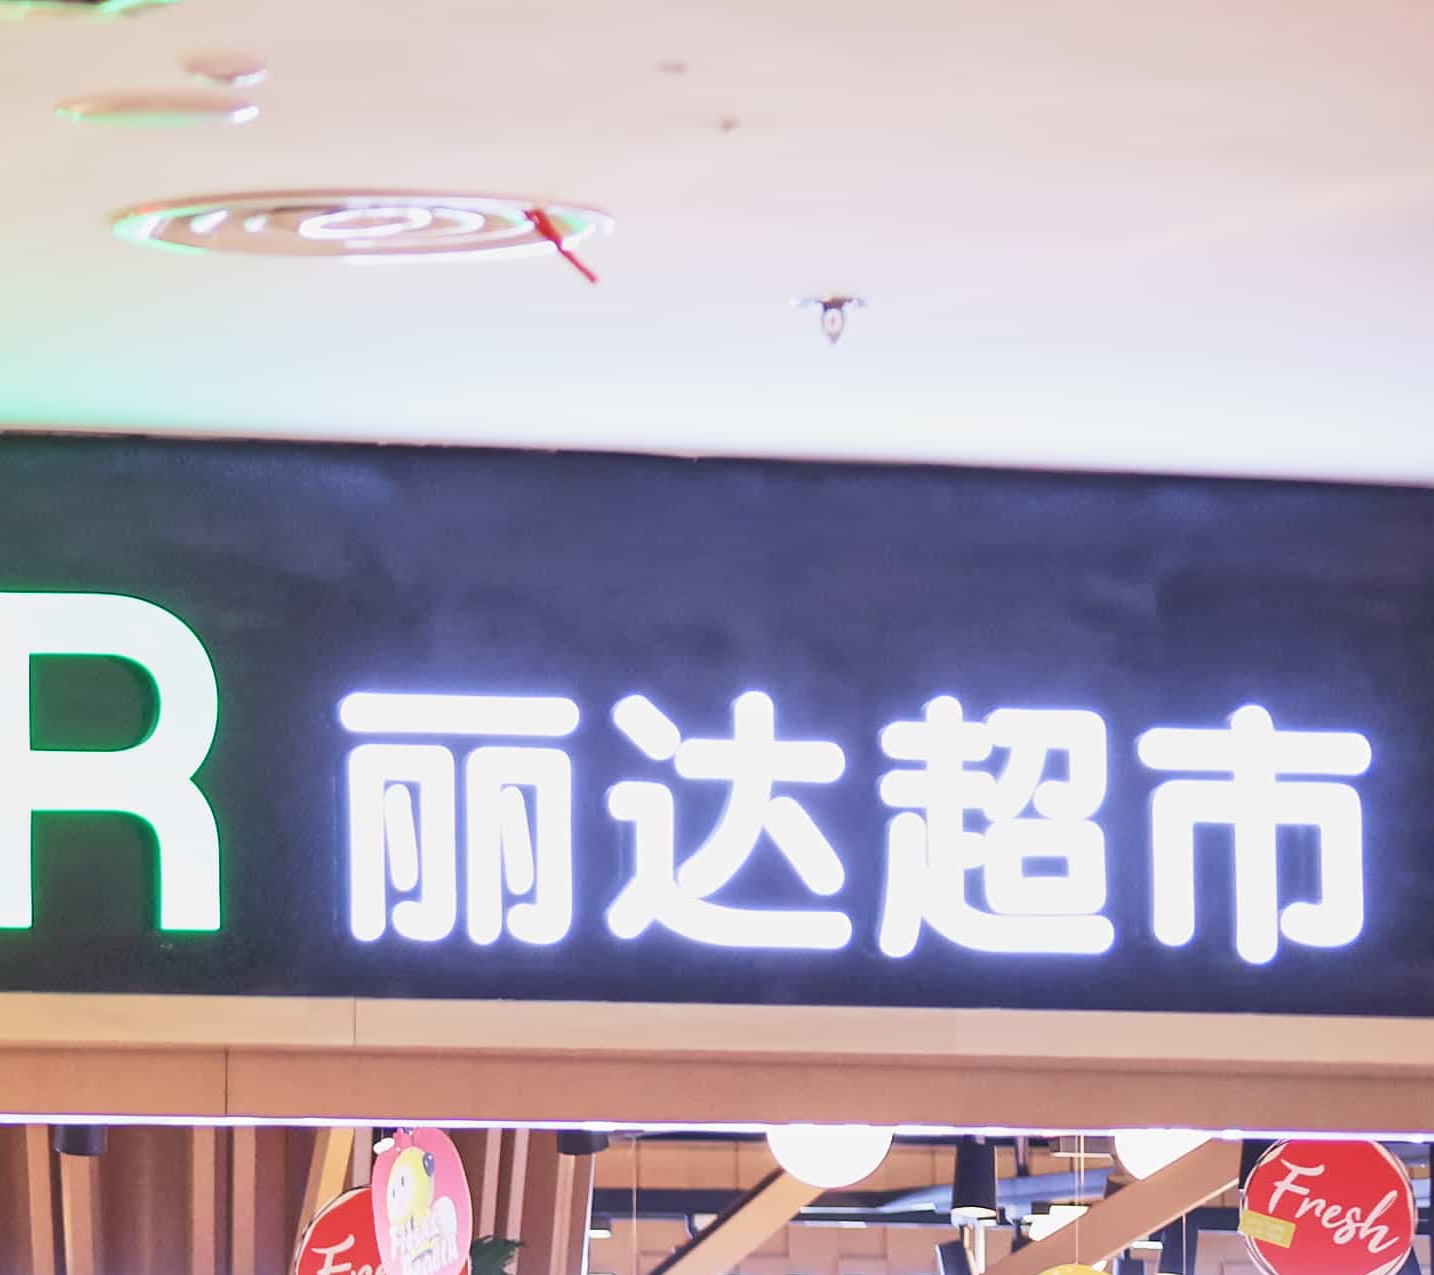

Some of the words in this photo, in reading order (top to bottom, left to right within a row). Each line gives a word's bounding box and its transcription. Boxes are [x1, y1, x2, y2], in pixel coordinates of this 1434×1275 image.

[338, 690, 1373, 965] 丽达超市
[1267, 1159, 1402, 1254] Fresh
